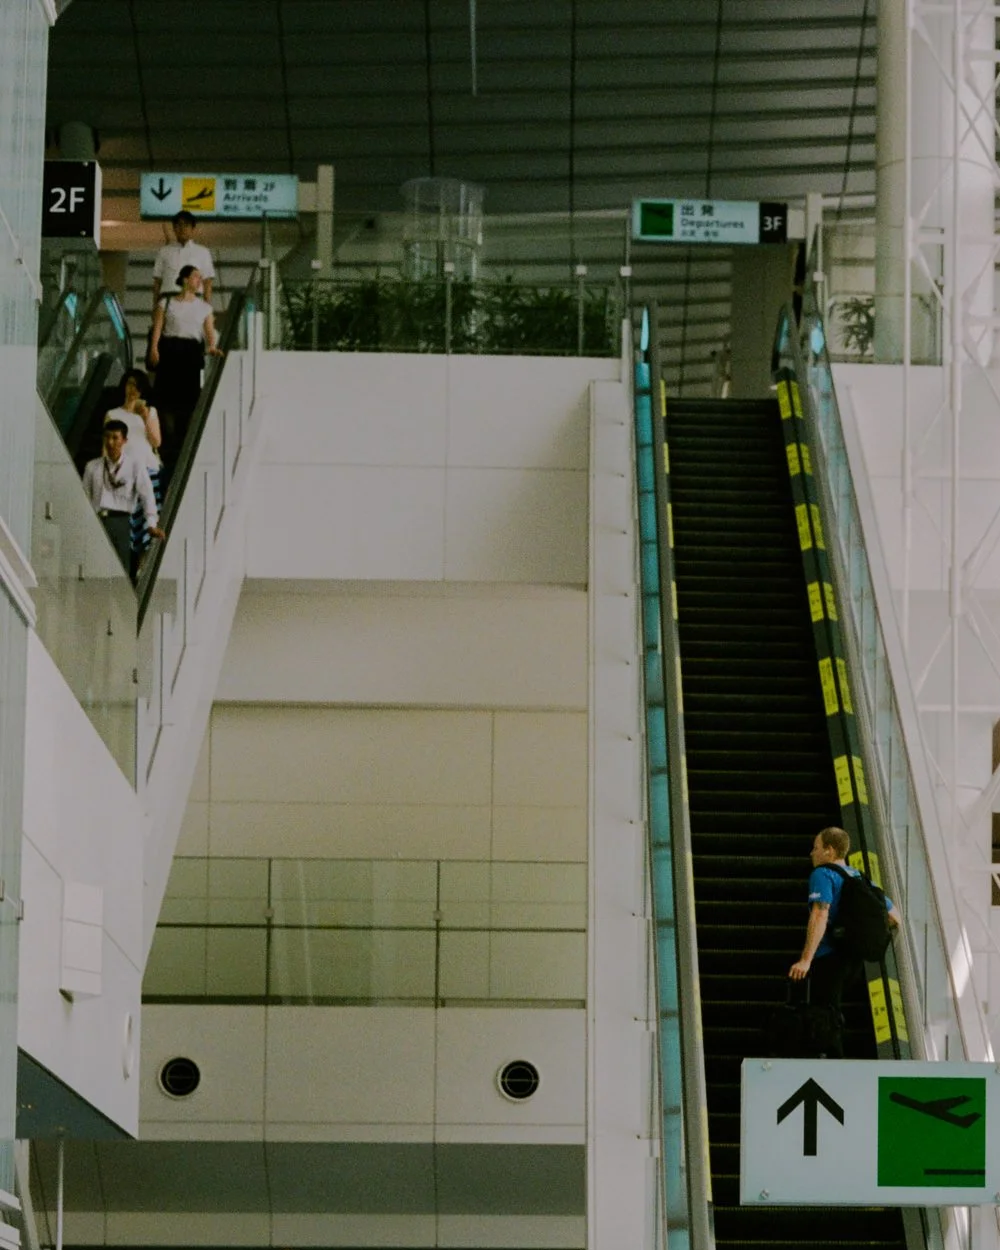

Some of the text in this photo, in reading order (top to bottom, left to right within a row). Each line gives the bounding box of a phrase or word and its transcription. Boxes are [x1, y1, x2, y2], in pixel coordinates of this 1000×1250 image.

[49, 187, 85, 213] 2F
[223, 192, 268, 203] Arrivals
[681, 218, 744, 229] Departures
[763, 216, 782, 231] 3F
